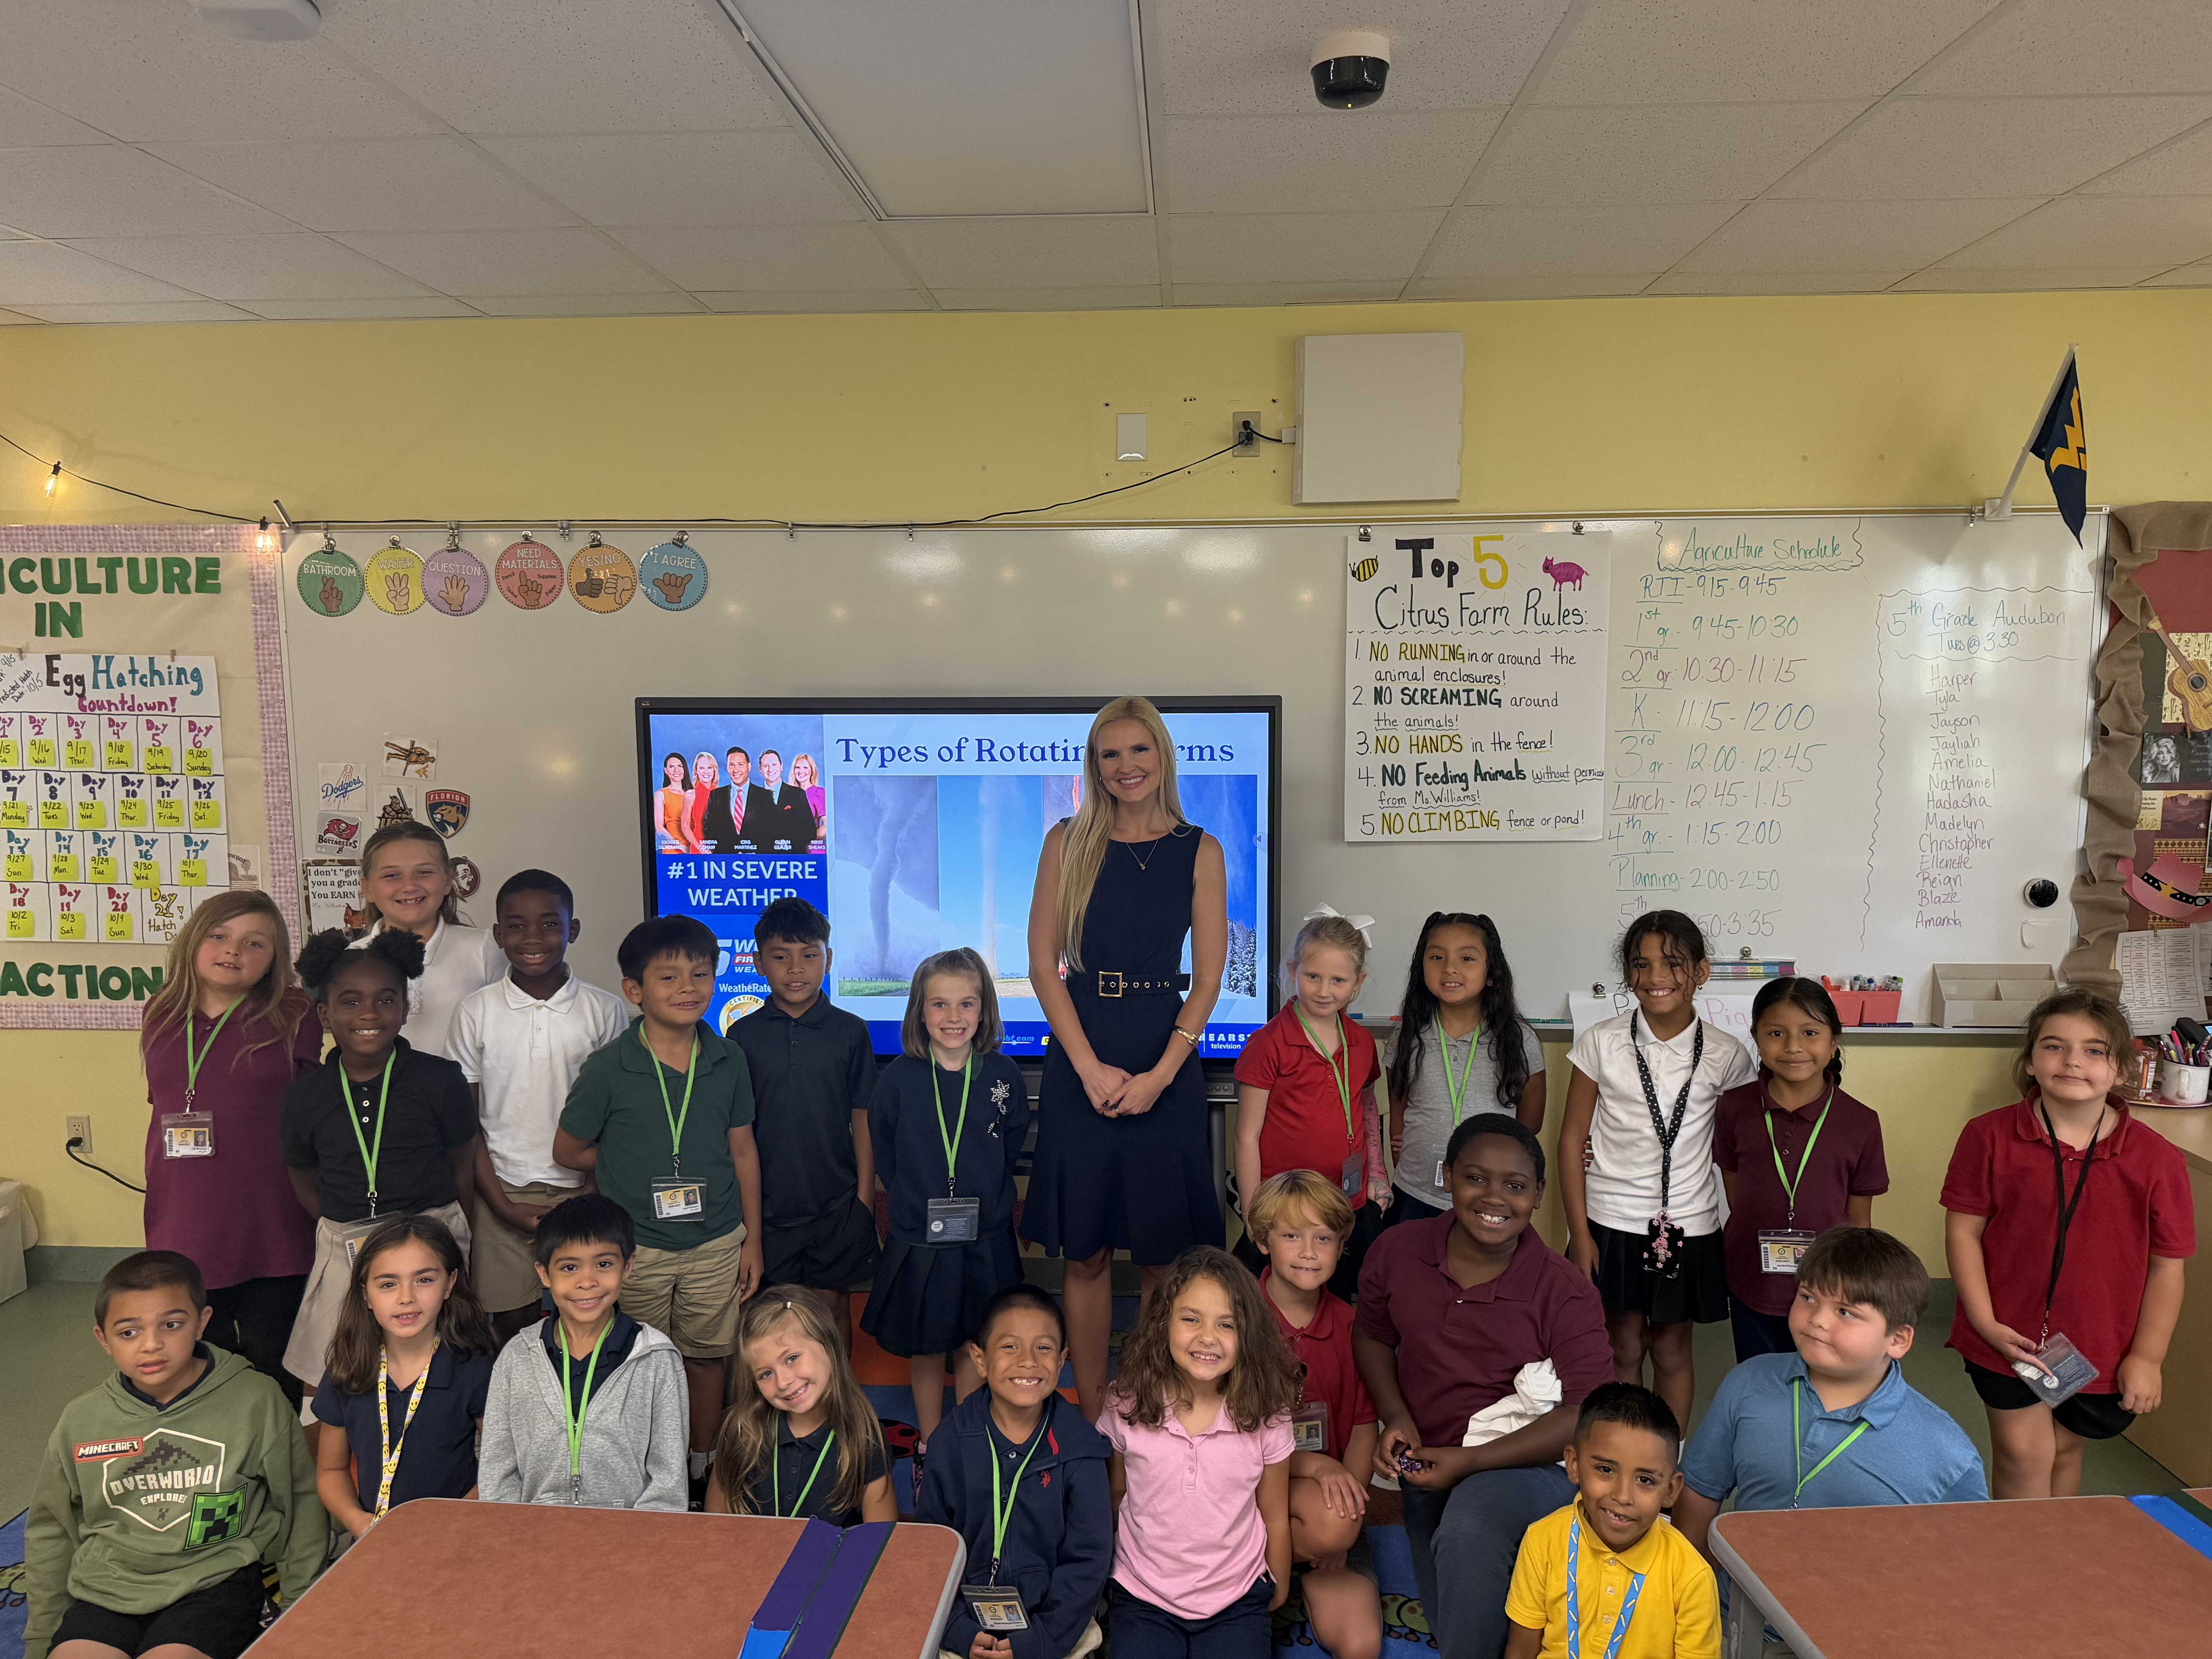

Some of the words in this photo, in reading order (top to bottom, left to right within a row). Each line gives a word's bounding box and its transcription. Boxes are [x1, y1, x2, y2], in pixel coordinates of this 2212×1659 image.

[517, 548, 541, 558] NEED
[1679, 527, 1763, 566] Agriculture
[1774, 536, 1842, 560] Schedule
[377, 558, 414, 570] WATER
[429, 562, 481, 576] QUESTION
[502, 560, 557, 569] MATERIALS
[579, 554, 620, 567] YES/NO
[653, 553, 659, 564] I
[661, 556, 696, 569] AGREE
[1395, 538, 1459, 588] Top
[1473, 535, 1509, 590] 5
[304, 564, 356, 576] BATHROOM
[1376, 584, 1449, 630] Citrus
[1460, 592, 1510, 626] Farm
[1524, 588, 1588, 626] Rules:
[1932, 602, 1977, 630] Grade
[1993, 600, 2065, 627] Audubon
[35, 602, 84, 638] IN
[1927, 631, 1965, 651] Tues
[1984, 631, 2018, 651] 3:30
[1369, 641, 1388, 661] NO
[1399, 644, 1465, 663] RUNNING
[1468, 646, 1478, 662] in
[1481, 649, 1494, 663] or
[1498, 648, 1541, 665] around
[1551, 646, 1577, 665] the
[45, 654, 86, 698] Egg
[91, 655, 203, 696] Hatching
[1375, 666, 1424, 682] animal
[1434, 668, 1506, 685] enclosures!
[1930, 663, 1977, 692] Harper
[78, 693, 177, 713] Countdown!
[1374, 686, 1392, 705] NO
[1401, 687, 1501, 708] SCREAMING
[1510, 692, 1558, 707] around
[1926, 689, 1960, 711] Tyla
[1632, 693, 1647, 728] K
[29, 715, 47, 726] Day
[108, 717, 127, 730] Day
[1374, 712, 1398, 728] the
[1405, 714, 1458, 728] animals!
[1930, 712, 1980, 734] Jayson
[32, 724, 44, 735] 2
[188, 720, 213, 738] Day
[31, 739, 50, 755] 9/16
[108, 742, 125, 753] 9/18
[192, 733, 202, 749] 6
[1374, 734, 1399, 754] NO
[1410, 734, 1462, 754] HANDS
[1472, 738, 1484, 752] in
[1491, 732, 1512, 750] the
[1516, 730, 1553, 750] fence!
[189, 749, 208, 759] 9/20
[836, 738, 928, 768] Types
[938, 737, 969, 762] of
[108, 757, 129, 767] Friday
[187, 762, 211, 775] Sunday
[1932, 752, 1989, 771] Amelia
[44, 773, 66, 786] Day
[1382, 764, 1406, 787] NO
[1416, 761, 1469, 791] Feeding
[1474, 758, 1526, 783] Animals
[1532, 765, 1570, 780] without
[1929, 769, 1996, 791] Nathaniel
[49, 785, 58, 800] 8
[321, 776, 365, 799] Dodgers
[43, 801, 62, 811] 9/22
[431, 793, 465, 802] FLORIDA
[1378, 791, 1406, 805] from
[1927, 792, 1992, 809] Hadasha
[1, 812, 25, 823] Monday
[1381, 812, 1403, 835] NO
[1408, 810, 1499, 833] CLIMBING
[1507, 811, 1534, 827] fence
[1541, 817, 1550, 826] or
[1554, 810, 1584, 830] pond!
[1925, 812, 1984, 839] Madelyn
[134, 834, 158, 849] Day
[1919, 833, 1995, 854] Christopher
[138, 849, 153, 860] 16
[134, 862, 152, 871] 9/30
[667, 861, 697, 879] #1
[704, 861, 726, 879] IN
[732, 861, 817, 879] SEVERE
[9, 883, 29, 898] Day
[1918, 890, 1961, 907] Blaze
[12, 911, 27, 919] 10/2
[1916, 910, 1961, 929] Amanda
[148, 919, 176, 932] Hatch
[0, 962, 163, 1001] ACTION
[77, 1440, 140, 1458] MINECRAFT
[110, 1465, 215, 1496] OVERWORLD
